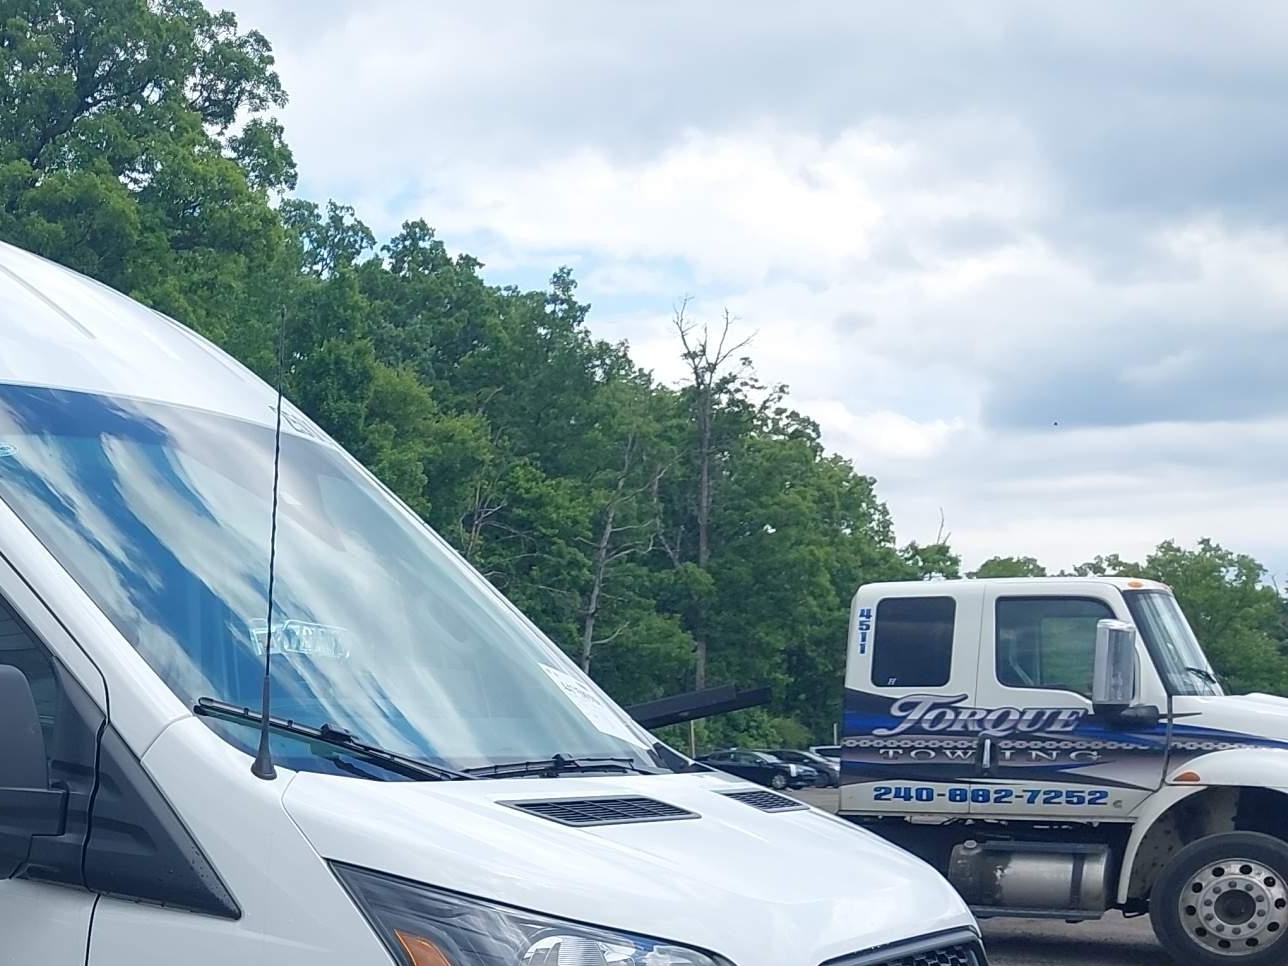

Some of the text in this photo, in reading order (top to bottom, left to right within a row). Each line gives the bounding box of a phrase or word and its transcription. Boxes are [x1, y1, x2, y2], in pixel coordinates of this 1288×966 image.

[858, 608, 872, 655] 4511
[872, 694, 1086, 737] TORQUE
[879, 748, 1103, 762] TOWING
[872, 786, 1109, 806] 240-882-7252
